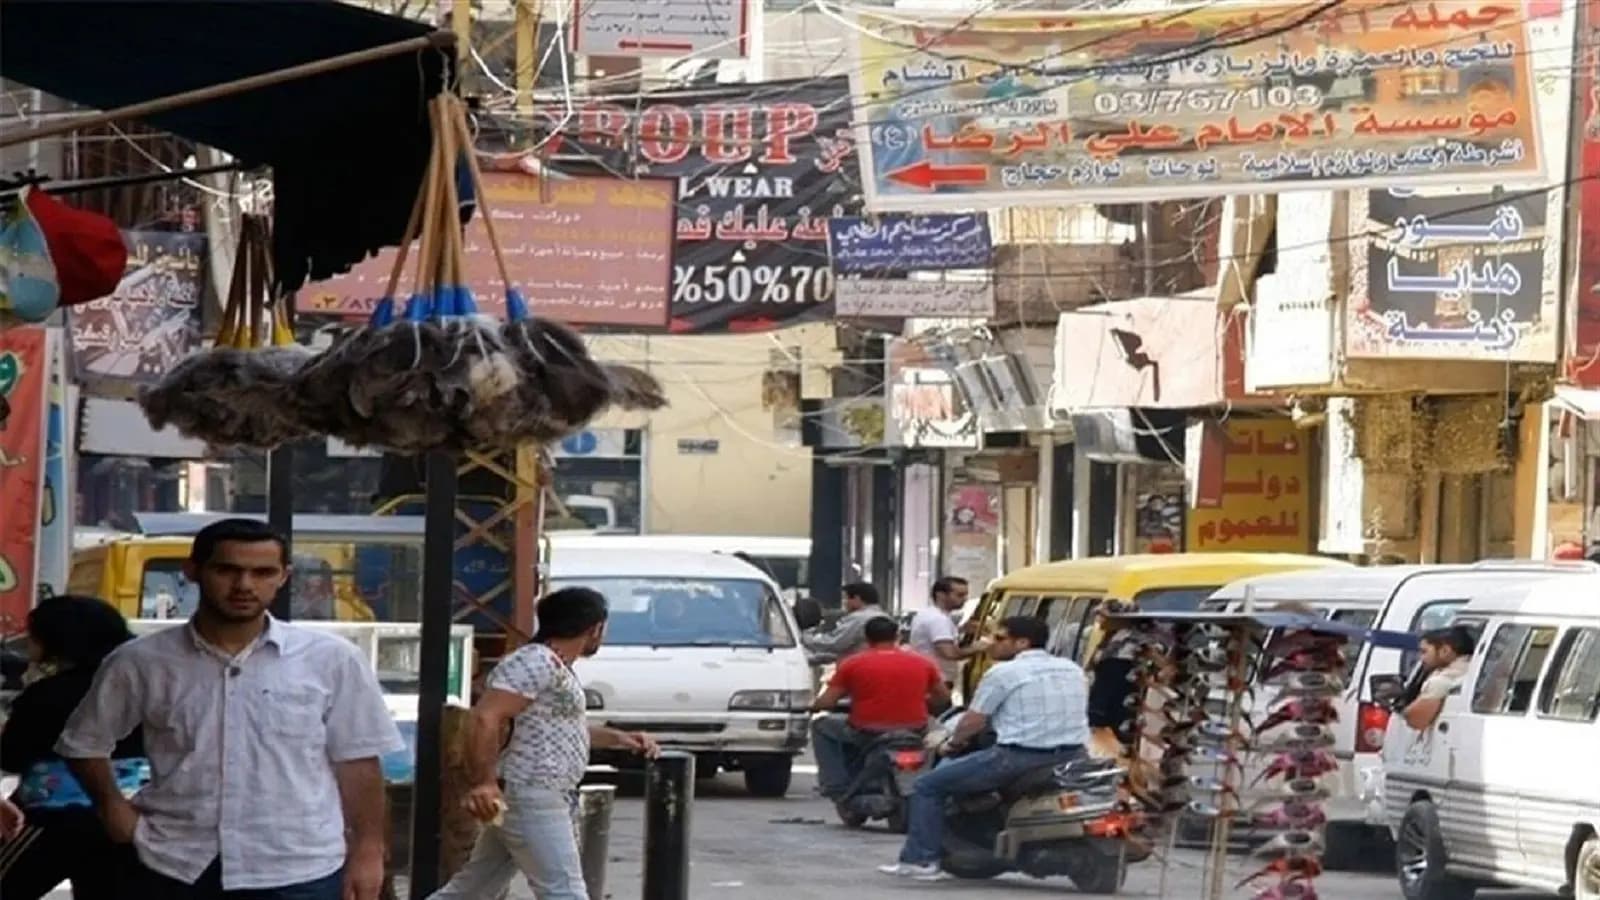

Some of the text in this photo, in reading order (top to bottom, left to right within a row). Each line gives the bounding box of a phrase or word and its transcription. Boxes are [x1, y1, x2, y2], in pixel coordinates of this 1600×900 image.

[1444, 41, 1514, 67] للحج
[1094, 85, 1324, 115] 03/767103
[1084, 120, 1182, 160] علي
[706, 176, 794, 198] WEAR
[1389, 206, 1524, 247] تمور
[1387, 254, 1522, 302] هدايا
[1383, 308, 1520, 351] زينة
[1224, 469, 1299, 500] دول
[1197, 510, 1299, 547] للعموم
